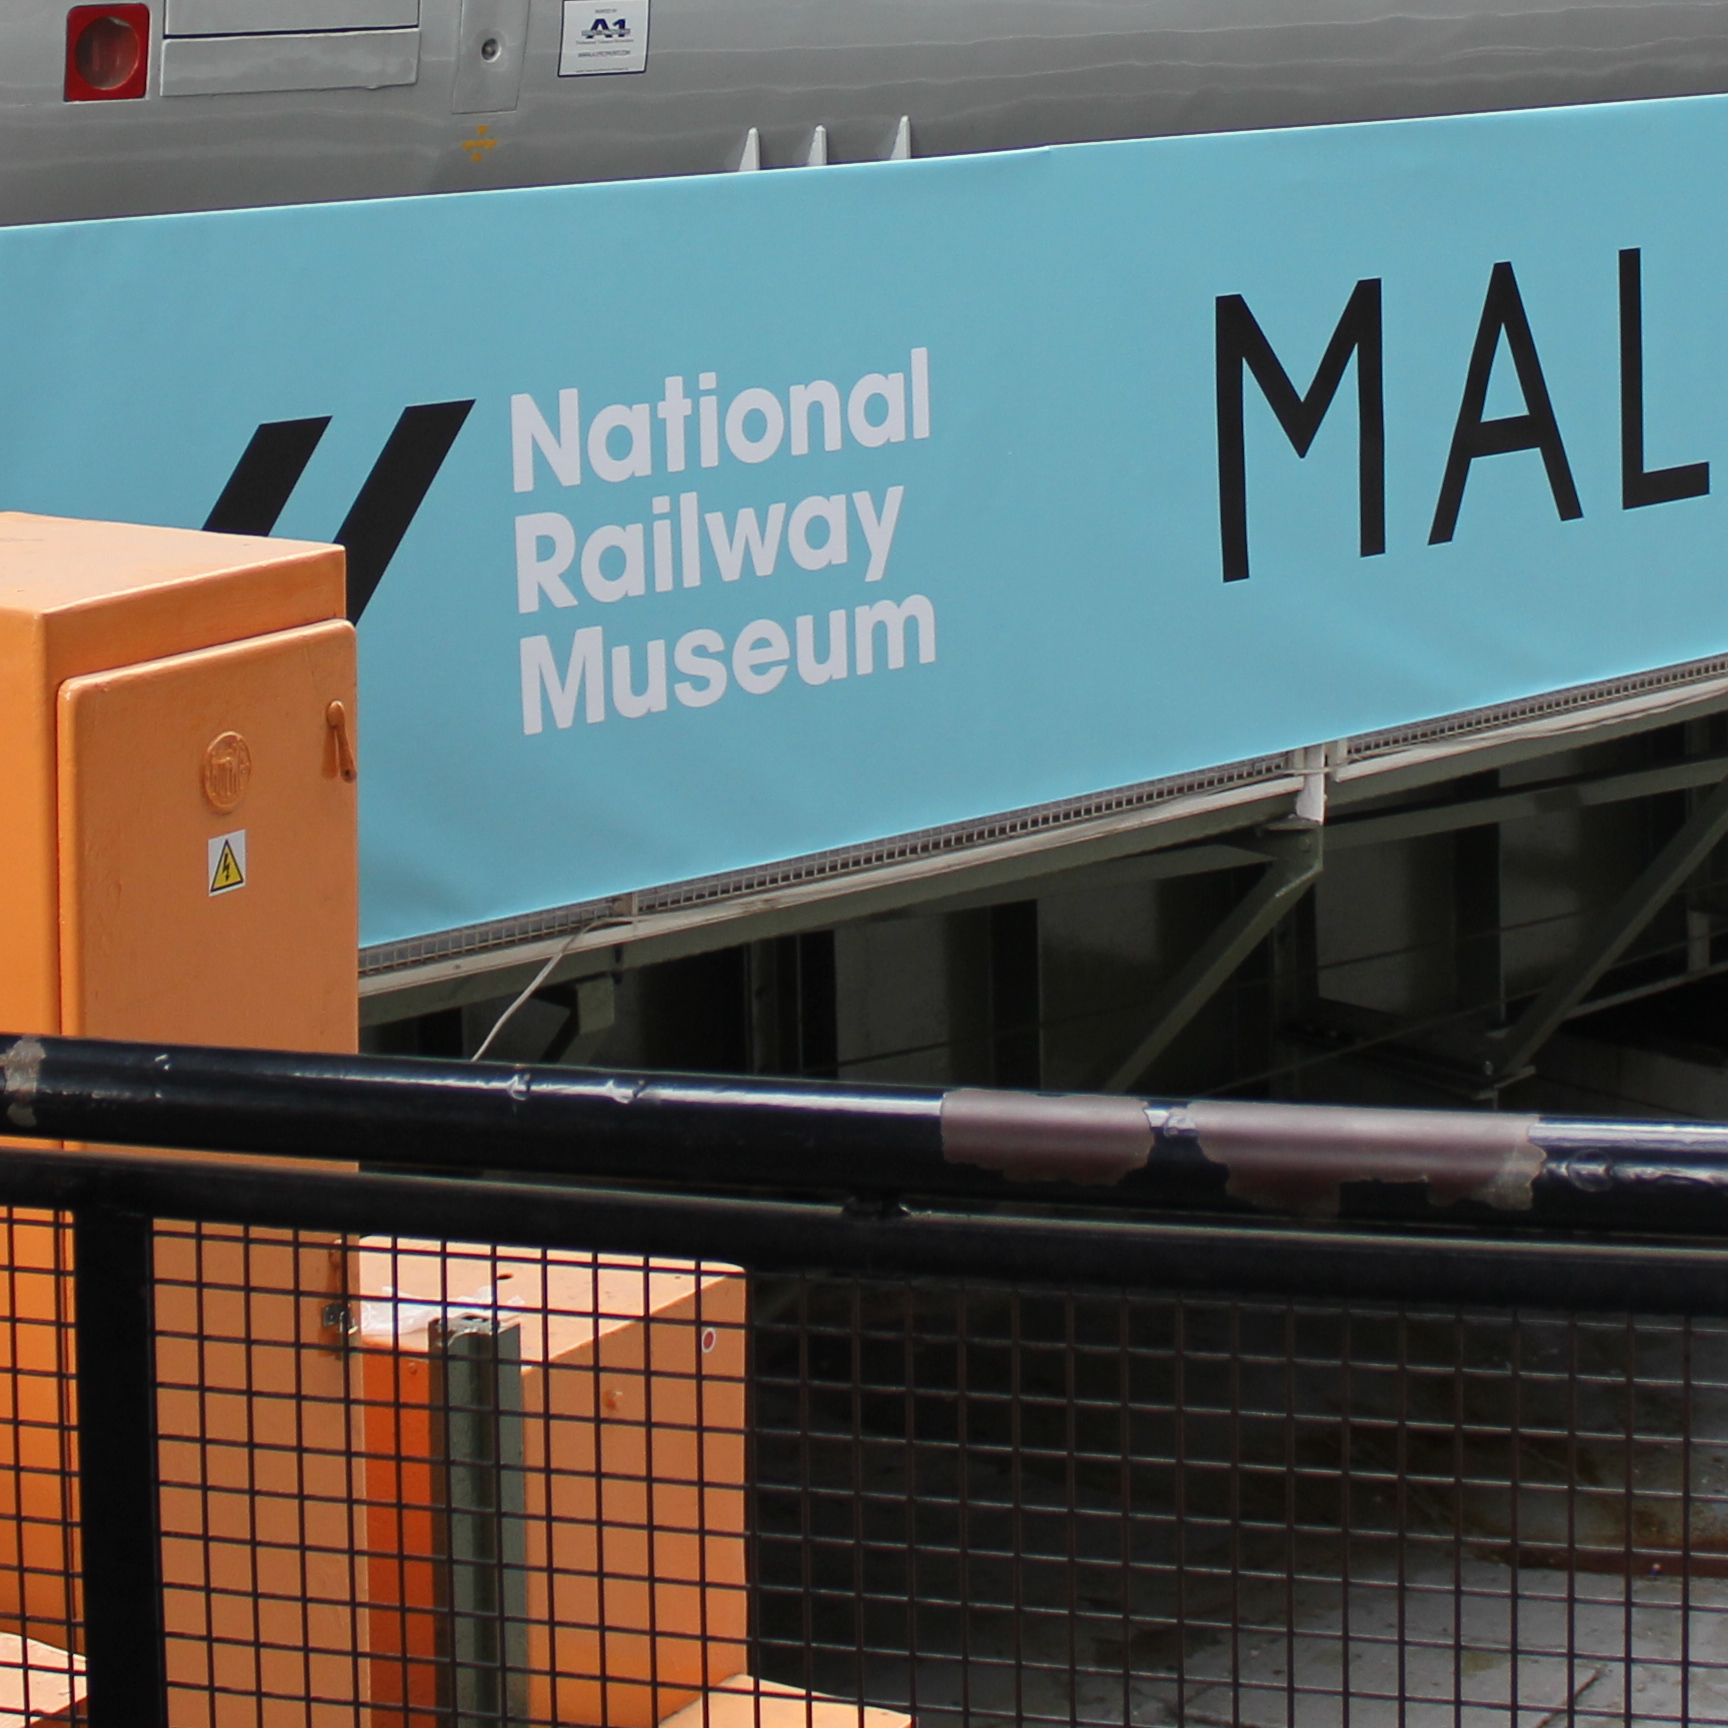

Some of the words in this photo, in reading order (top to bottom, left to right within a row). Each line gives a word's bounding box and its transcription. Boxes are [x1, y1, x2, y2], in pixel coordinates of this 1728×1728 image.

[511, 347, 930, 493] National
[515, 485, 905, 614] Railway
[519, 593, 937, 735] Museum
